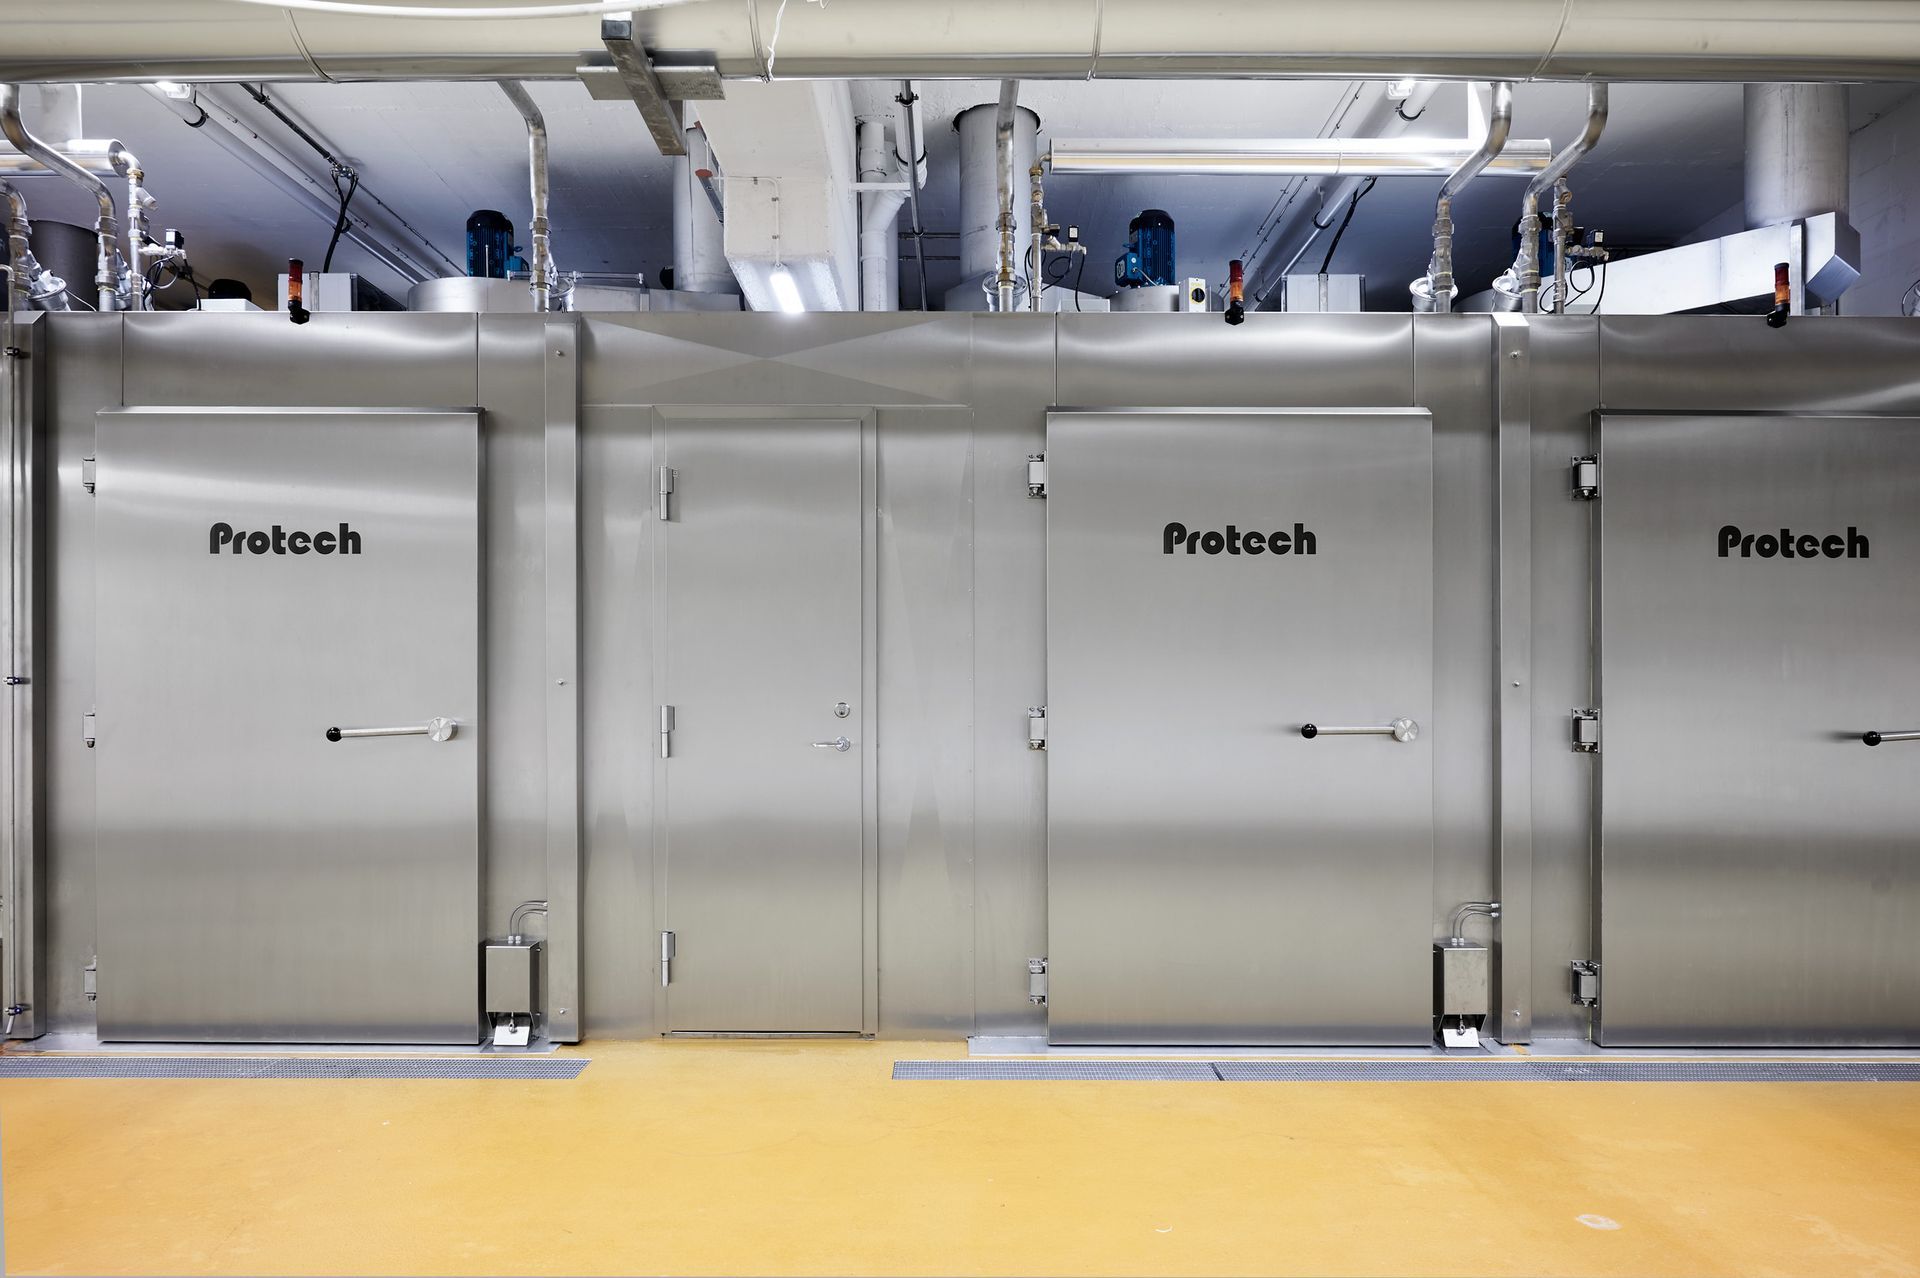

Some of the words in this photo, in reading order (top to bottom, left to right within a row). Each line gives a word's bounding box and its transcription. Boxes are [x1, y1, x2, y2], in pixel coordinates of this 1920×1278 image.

[209, 522, 362, 555] Protech
[1163, 522, 1317, 556] Protech
[1717, 524, 1870, 559] Protech
